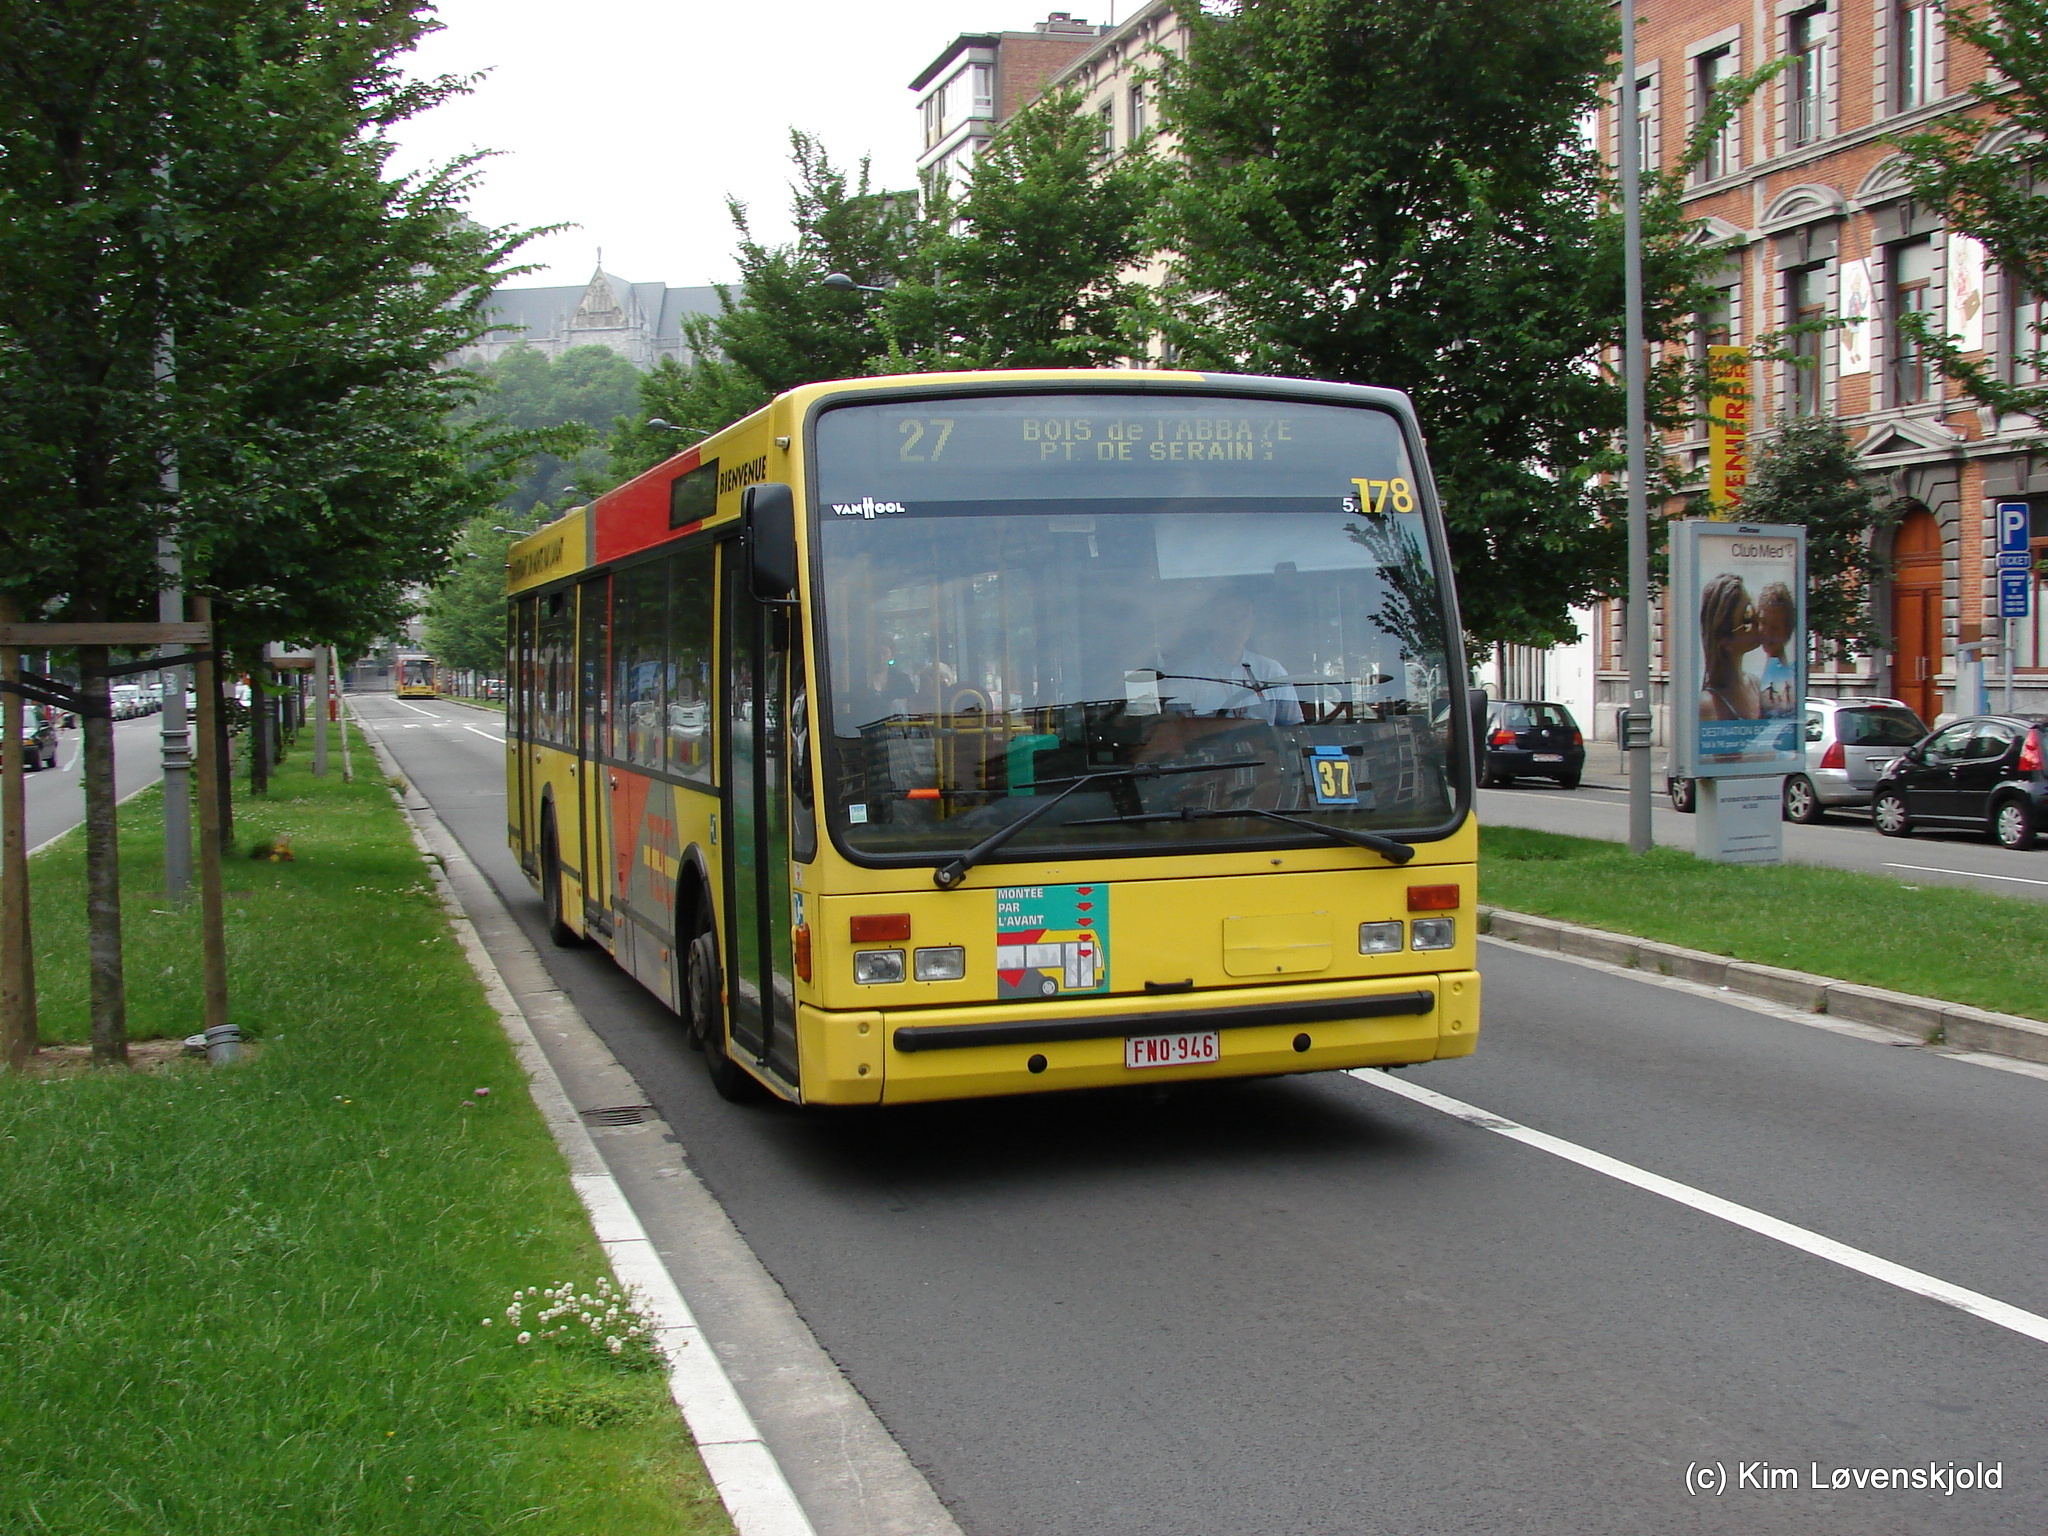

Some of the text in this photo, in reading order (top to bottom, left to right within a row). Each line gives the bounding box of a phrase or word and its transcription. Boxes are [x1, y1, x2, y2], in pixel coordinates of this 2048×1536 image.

[900, 419, 954, 461] 27
[1023, 419, 1091, 440] BOIS
[1108, 419, 1144, 440] de
[1097, 441, 1133, 461] DE
[720, 455, 767, 495] BIENVENUE
[2002, 510, 2025, 545] P
[1318, 761, 1349, 797] 37
[998, 902, 1020, 914] PAR
[998, 915, 1044, 927] L'AVANT
